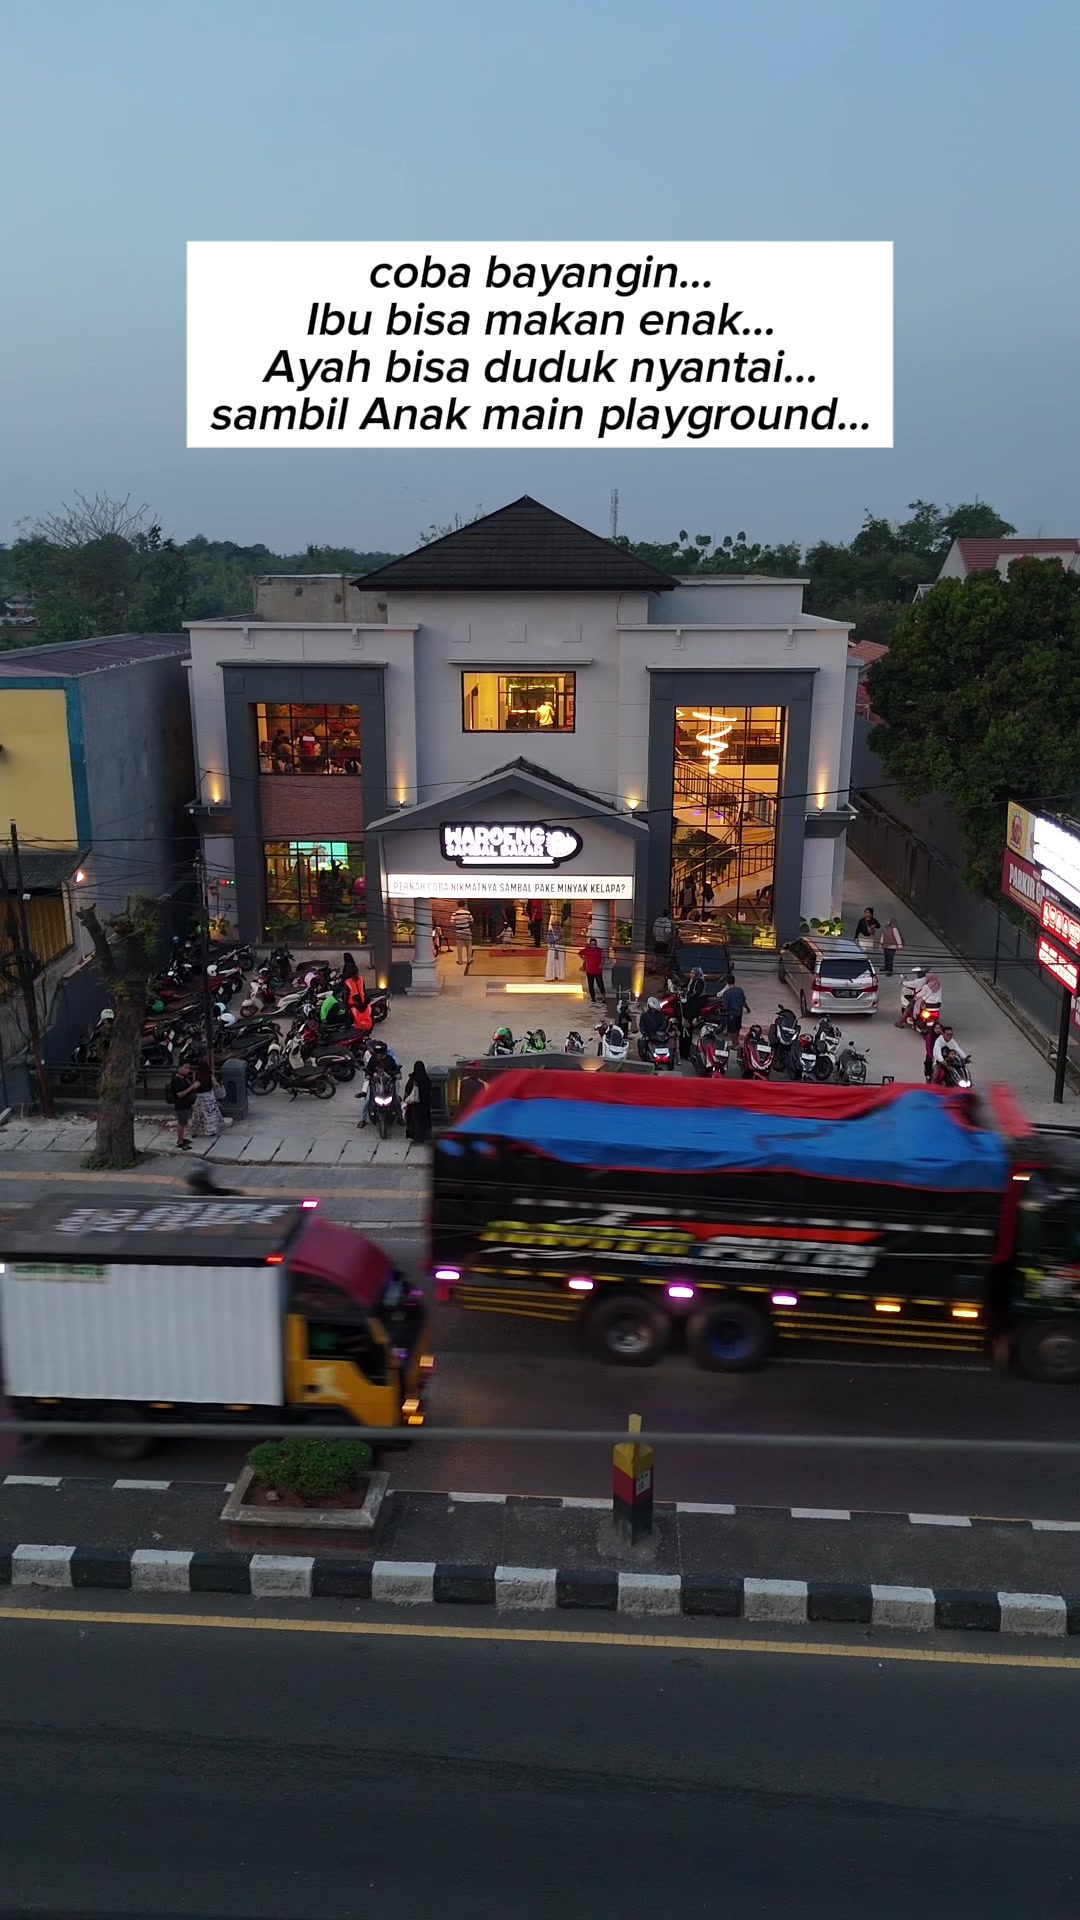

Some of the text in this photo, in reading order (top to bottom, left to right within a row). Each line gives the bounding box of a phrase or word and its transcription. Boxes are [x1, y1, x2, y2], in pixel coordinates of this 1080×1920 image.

[393, 881, 626, 893] PERNAH COBA NIKMATNYA SAMBAL PAKE MINYAK KELAPA?
